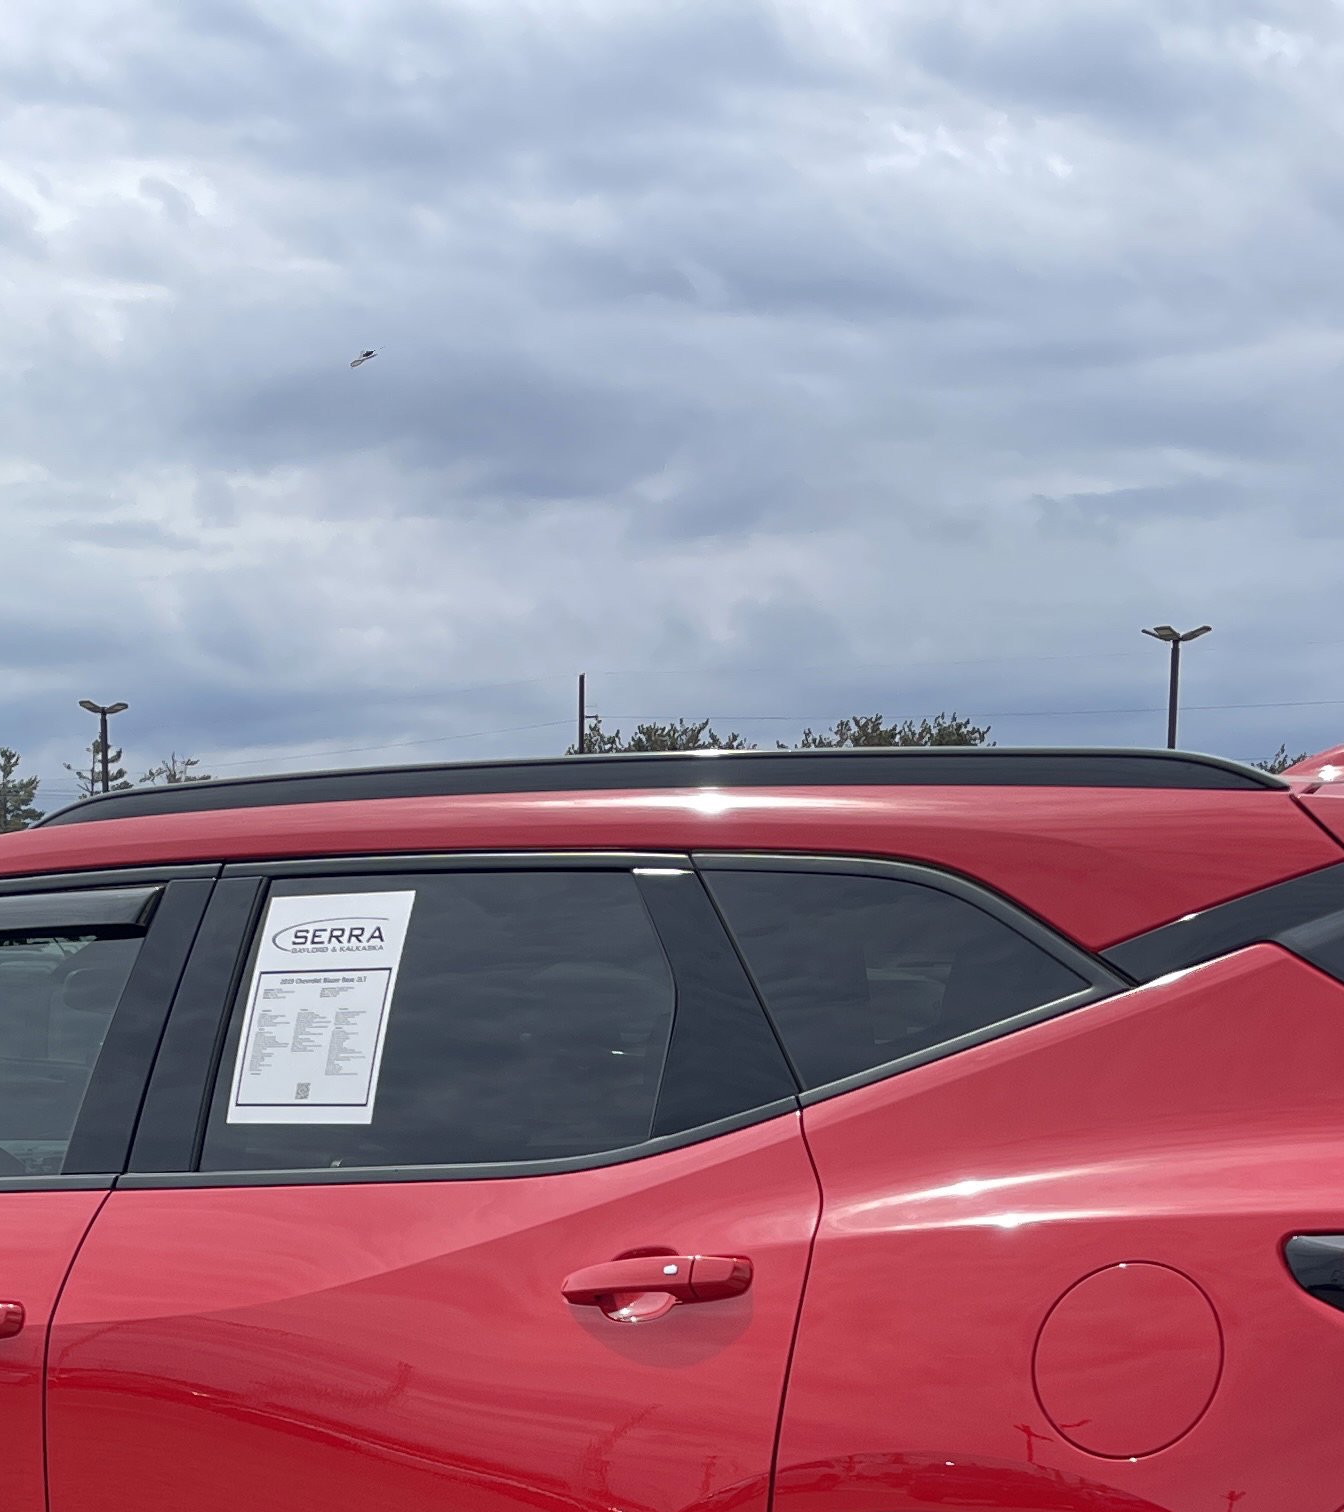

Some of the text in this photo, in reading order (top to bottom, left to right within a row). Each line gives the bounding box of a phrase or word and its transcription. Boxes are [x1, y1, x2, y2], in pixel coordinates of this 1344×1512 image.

[291, 926, 385, 946] SERRA
[291, 944, 384, 954] GAYLORD & KALKASKA
[295, 977, 322, 985] Chevrolet
[323, 976, 341, 984] Blazer
